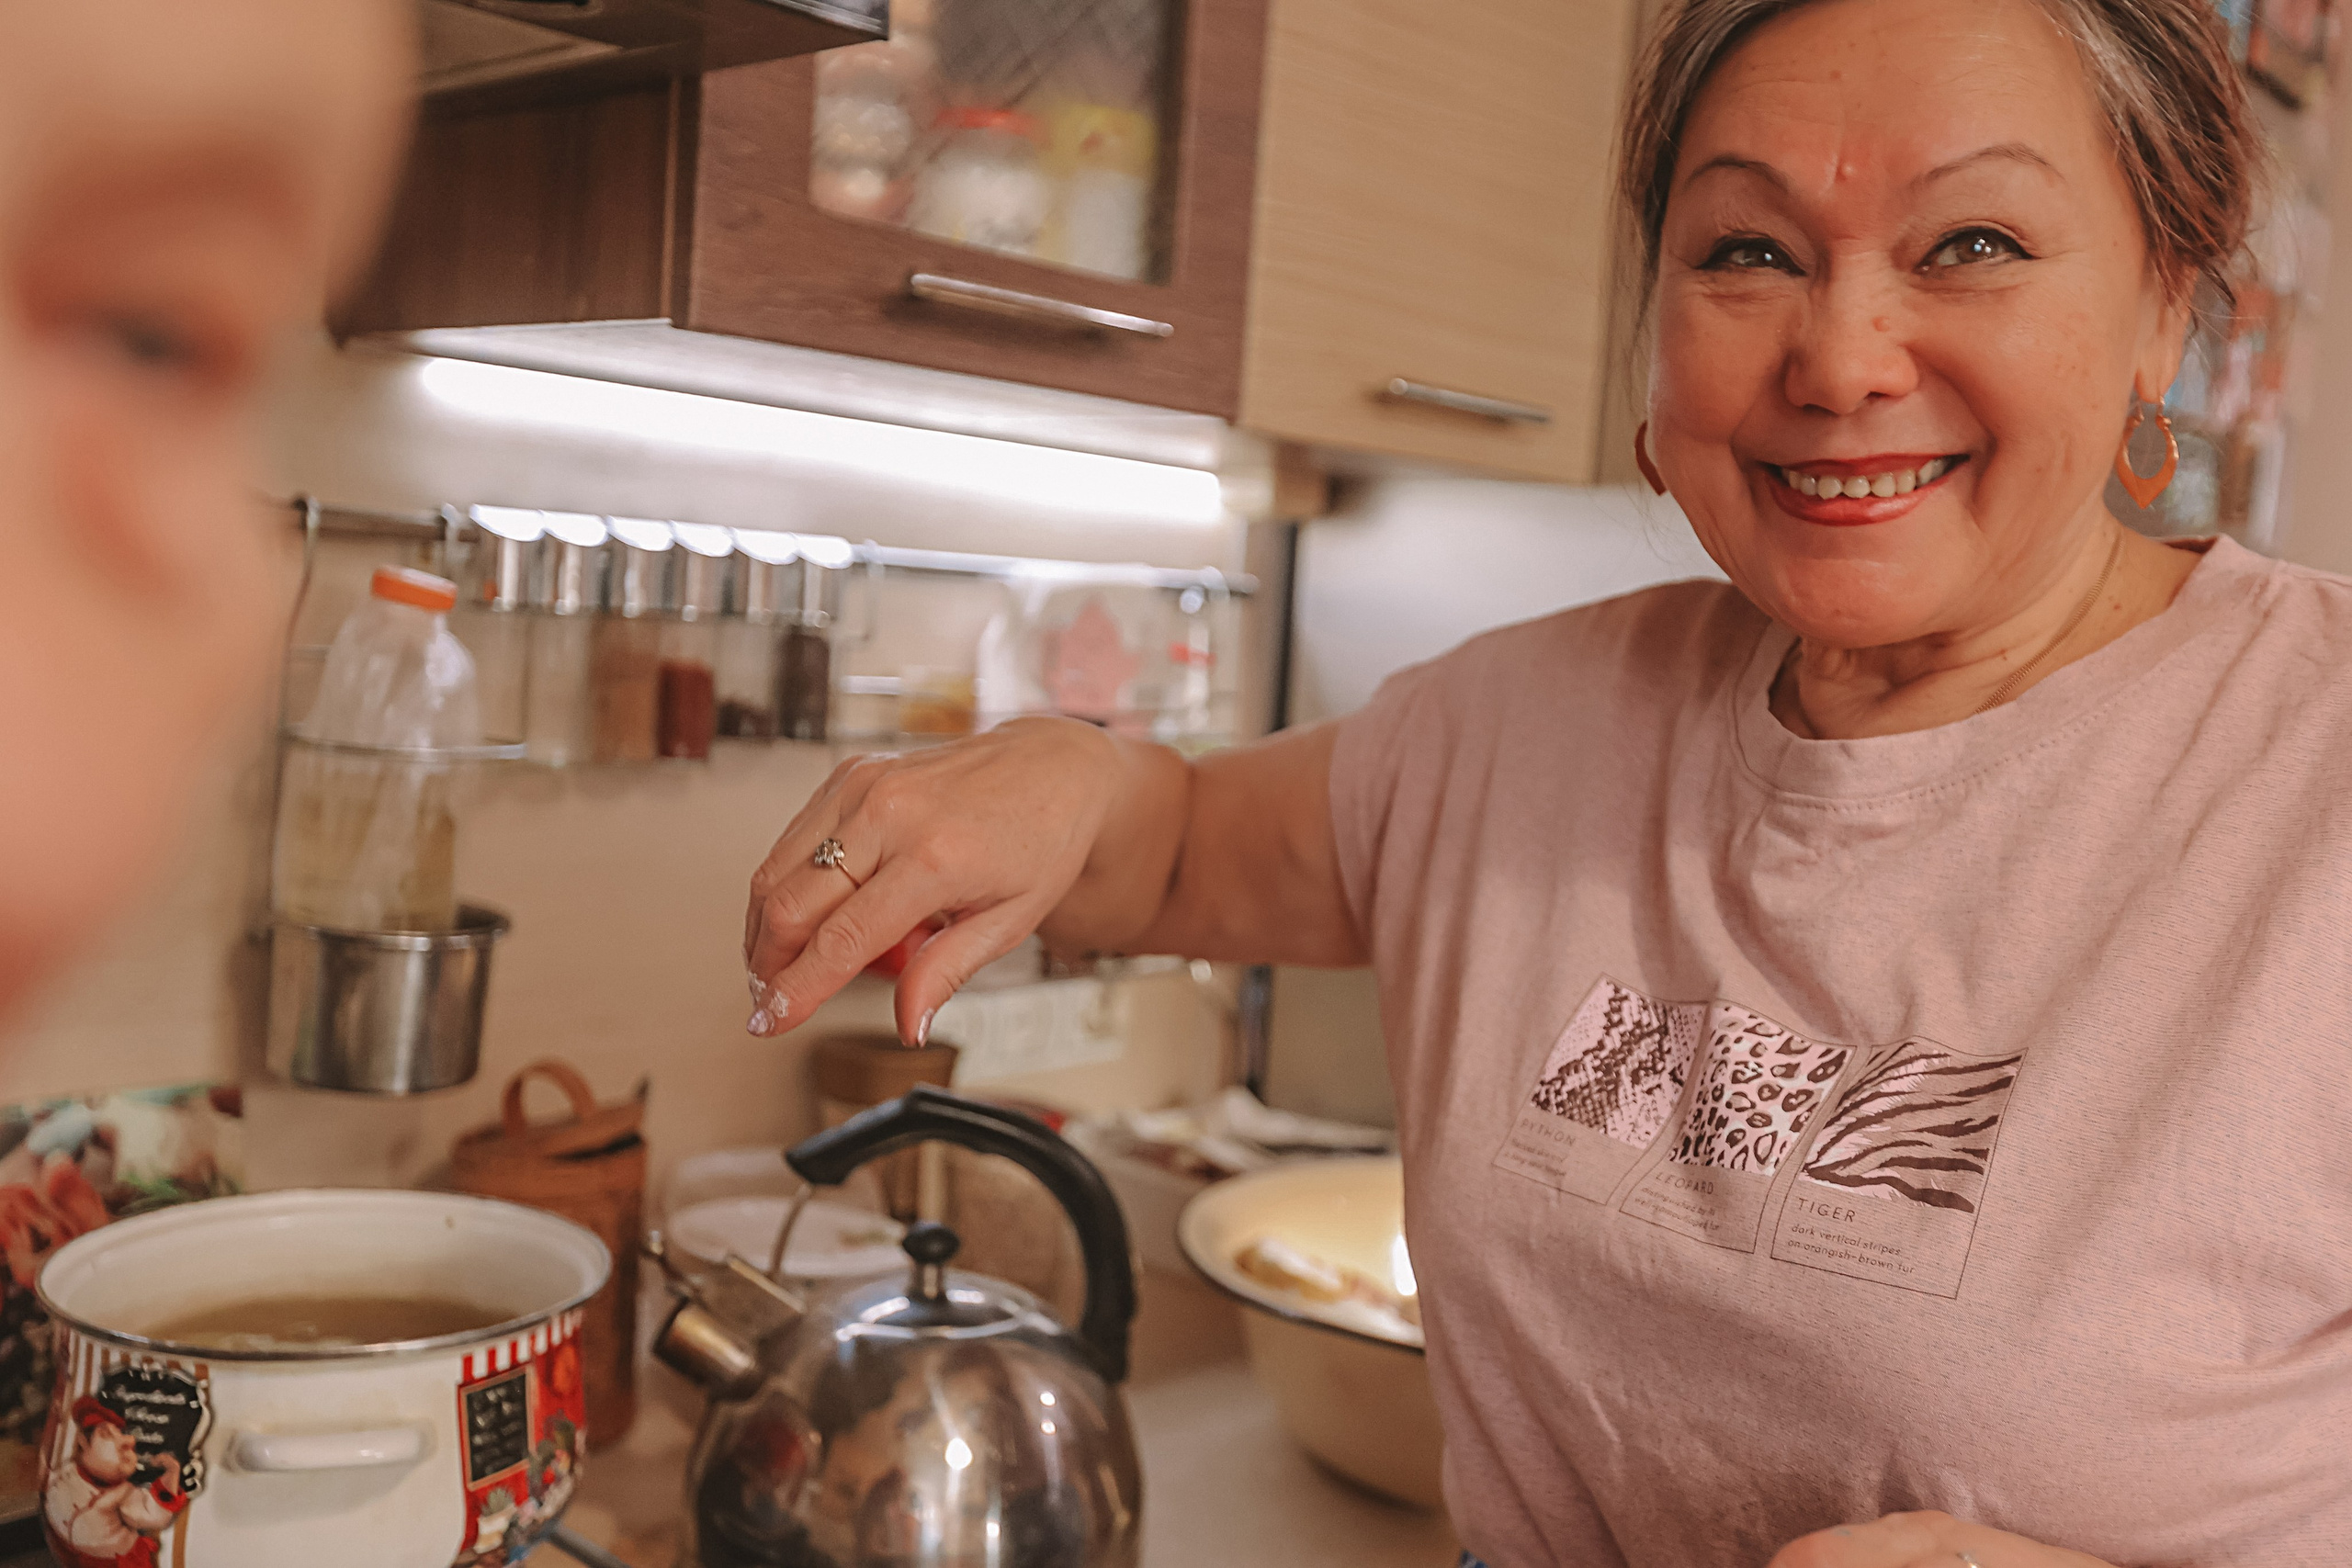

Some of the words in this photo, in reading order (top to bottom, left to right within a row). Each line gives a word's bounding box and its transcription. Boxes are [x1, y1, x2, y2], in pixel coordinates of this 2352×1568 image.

[1520, 1118, 1577, 1147] PYTHON
[1656, 1172, 1714, 1195] LEOPARD
[1797, 1197, 1857, 1223] TIGER
[1792, 1224, 1815, 1235] dark
[1819, 1232, 1861, 1247] vertical
[1863, 1241, 1902, 1256] stripes
[1787, 1240, 1801, 1248] on
[1804, 1244, 1894, 1269] orangish-brown
[1897, 1261, 1915, 1274] fur
